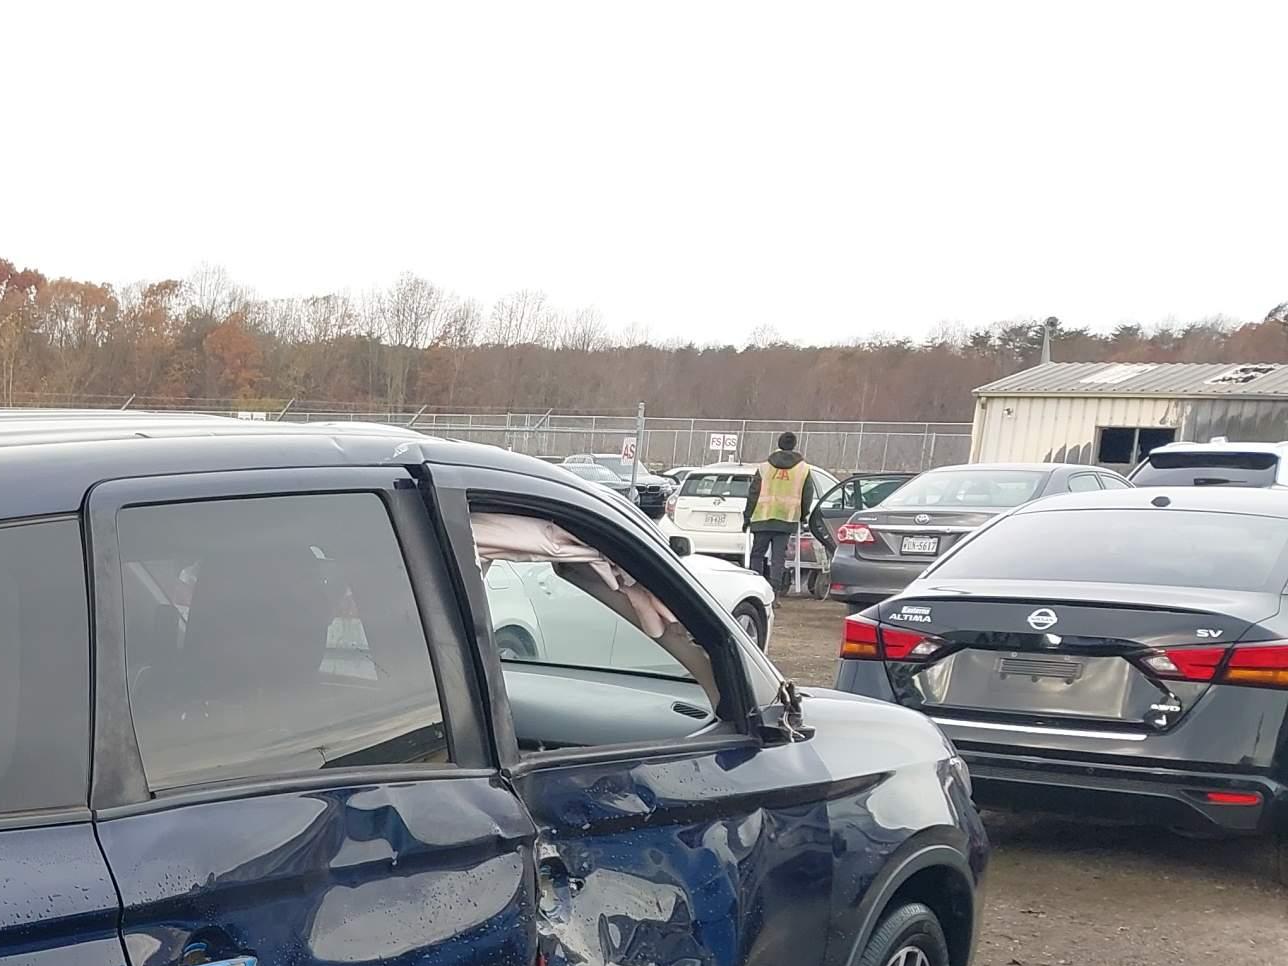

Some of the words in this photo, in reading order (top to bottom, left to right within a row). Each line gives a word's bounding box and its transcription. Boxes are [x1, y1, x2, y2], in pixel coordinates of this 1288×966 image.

[711, 437, 722, 447] FS
[724, 437, 737, 447] GS
[622, 443, 636, 460] AS
[888, 612, 932, 623] ALTIMA
[1196, 629, 1224, 638] SV
[1150, 703, 1181, 712] AWD
